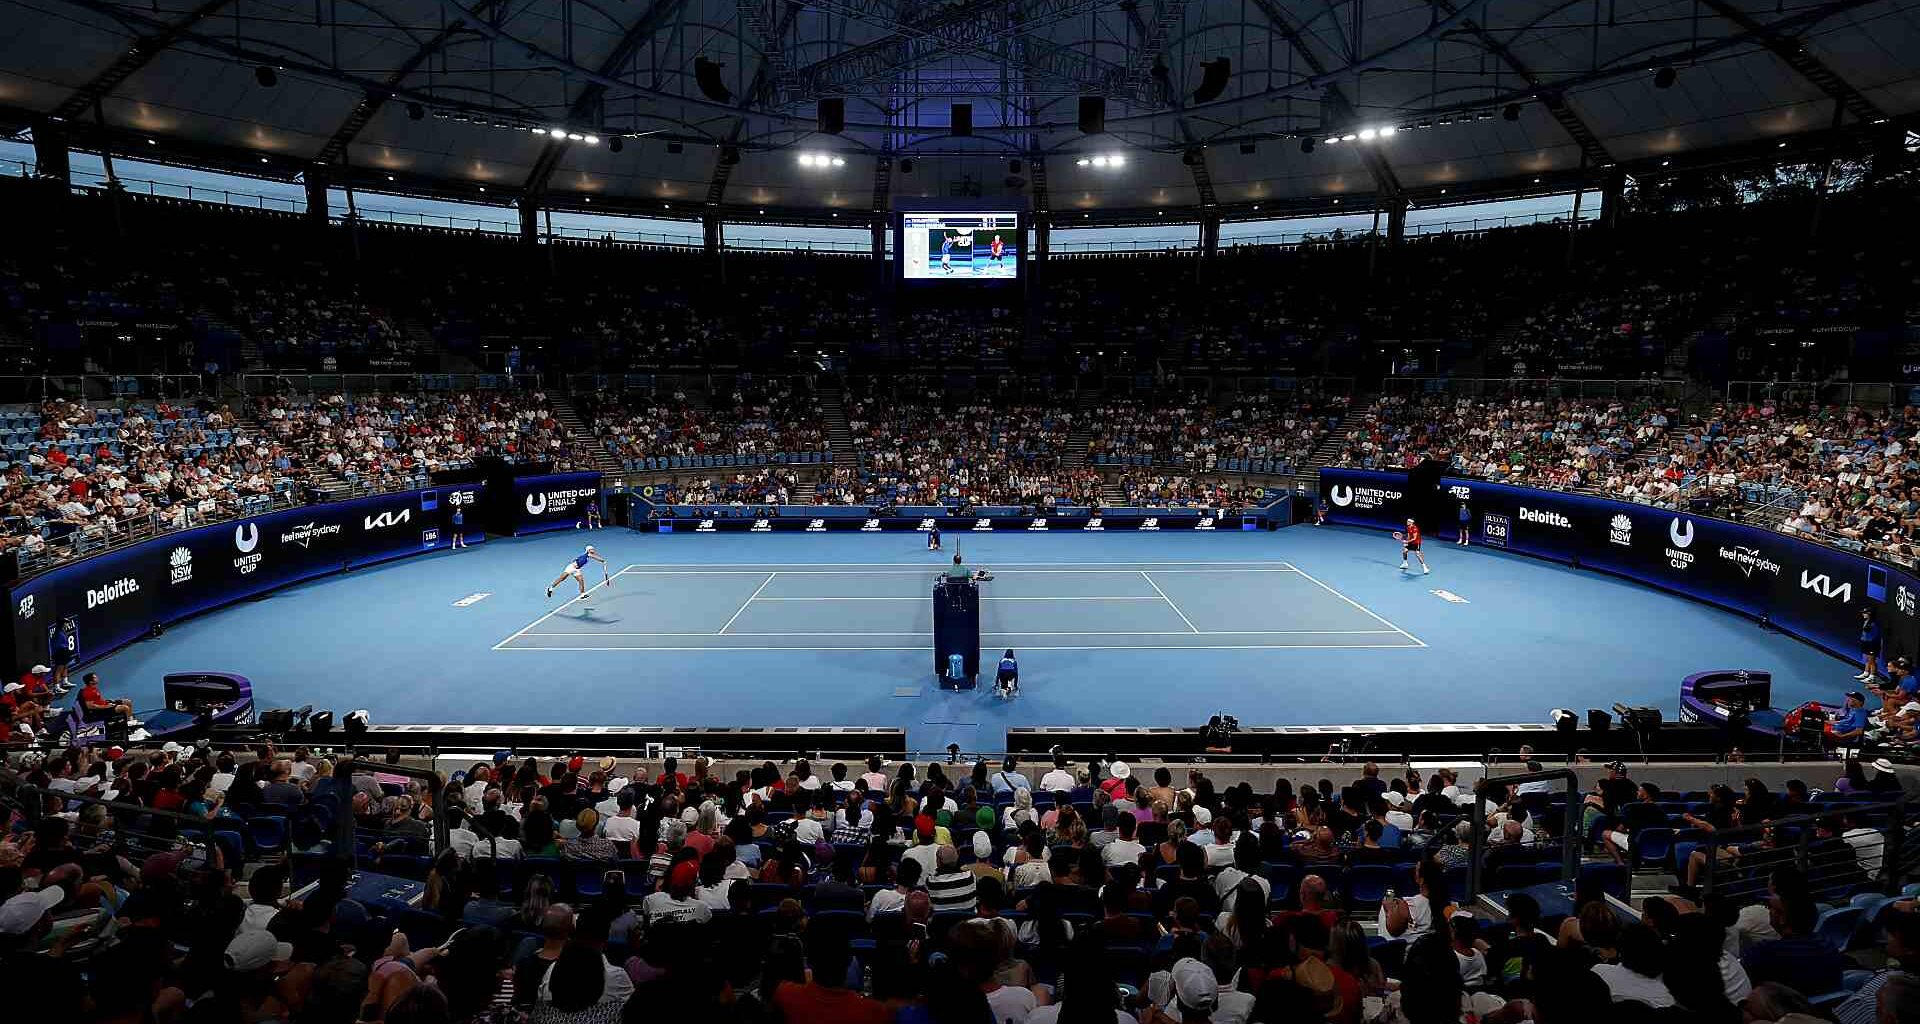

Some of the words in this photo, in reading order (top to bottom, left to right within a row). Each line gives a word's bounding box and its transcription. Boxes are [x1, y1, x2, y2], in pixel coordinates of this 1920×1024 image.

[547, 489, 578, 500] UNITED
[578, 488, 597, 497] CUP
[1354, 495, 1383, 506] FINALS
[1355, 487, 1385, 498] UNITED
[1385, 490, 1403, 500] CUP
[547, 497, 577, 507] FINALS
[1519, 506, 1572, 528] Deloitte.
[281, 531, 295, 544] feel
[295, 529, 311, 540] new
[312, 524, 341, 538] sydney
[1486, 524, 1506, 537] 0:38
[1610, 529, 1632, 542] NSW
[234, 552, 262, 568] UNITED
[1665, 547, 1694, 562] UNITED
[1719, 546, 1737, 560] feel
[1737, 552, 1756, 565] new
[1756, 558, 1781, 576] sydney
[240, 563, 257, 575] CUP
[1670, 558, 1688, 570] CUP
[171, 563, 192, 581] NSW
[87, 577, 140, 610] Deloitte.
[67, 635, 76, 651] 8
